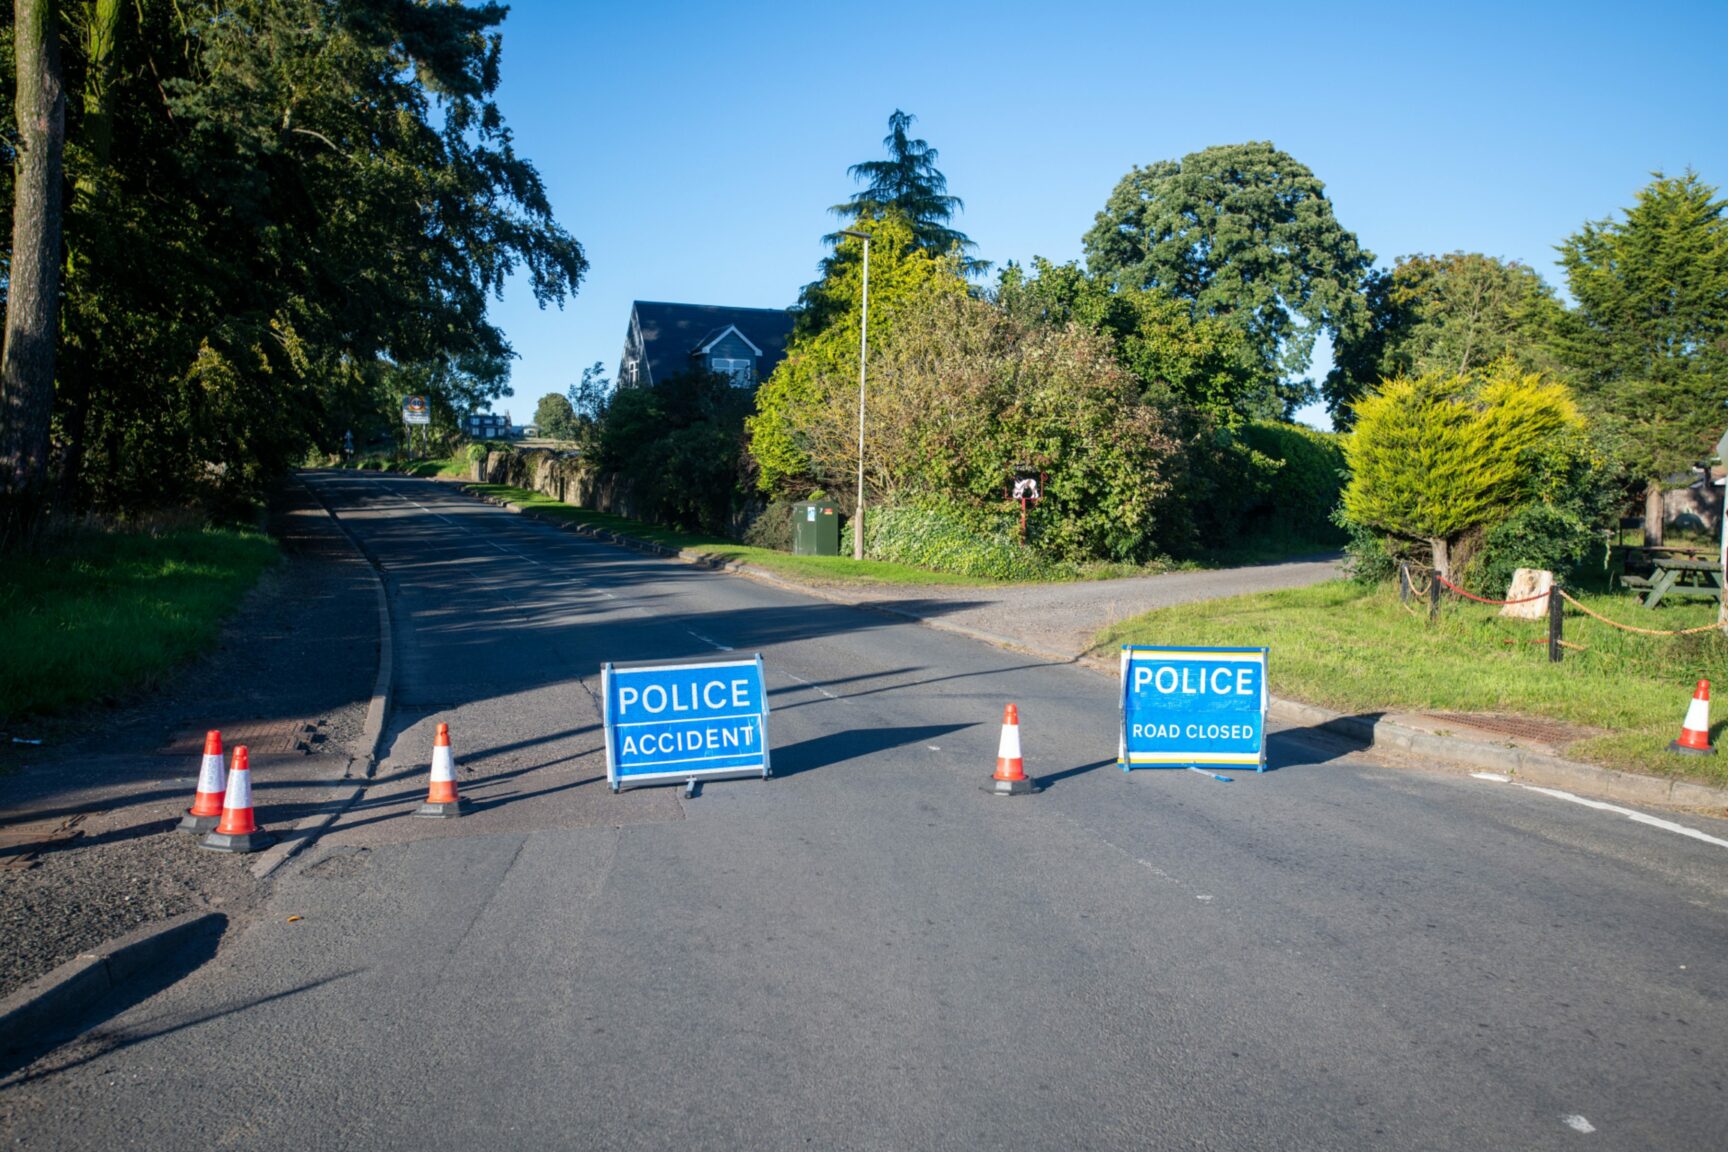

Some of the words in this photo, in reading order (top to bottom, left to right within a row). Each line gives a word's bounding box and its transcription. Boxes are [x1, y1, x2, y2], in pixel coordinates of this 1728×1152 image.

[1134, 666, 1253, 695] POLICE
[619, 679, 750, 715] POLICE
[622, 726, 753, 756] ACCIDENT
[1133, 724, 1180, 738] ROAD
[1186, 724, 1253, 739] CLOSED
